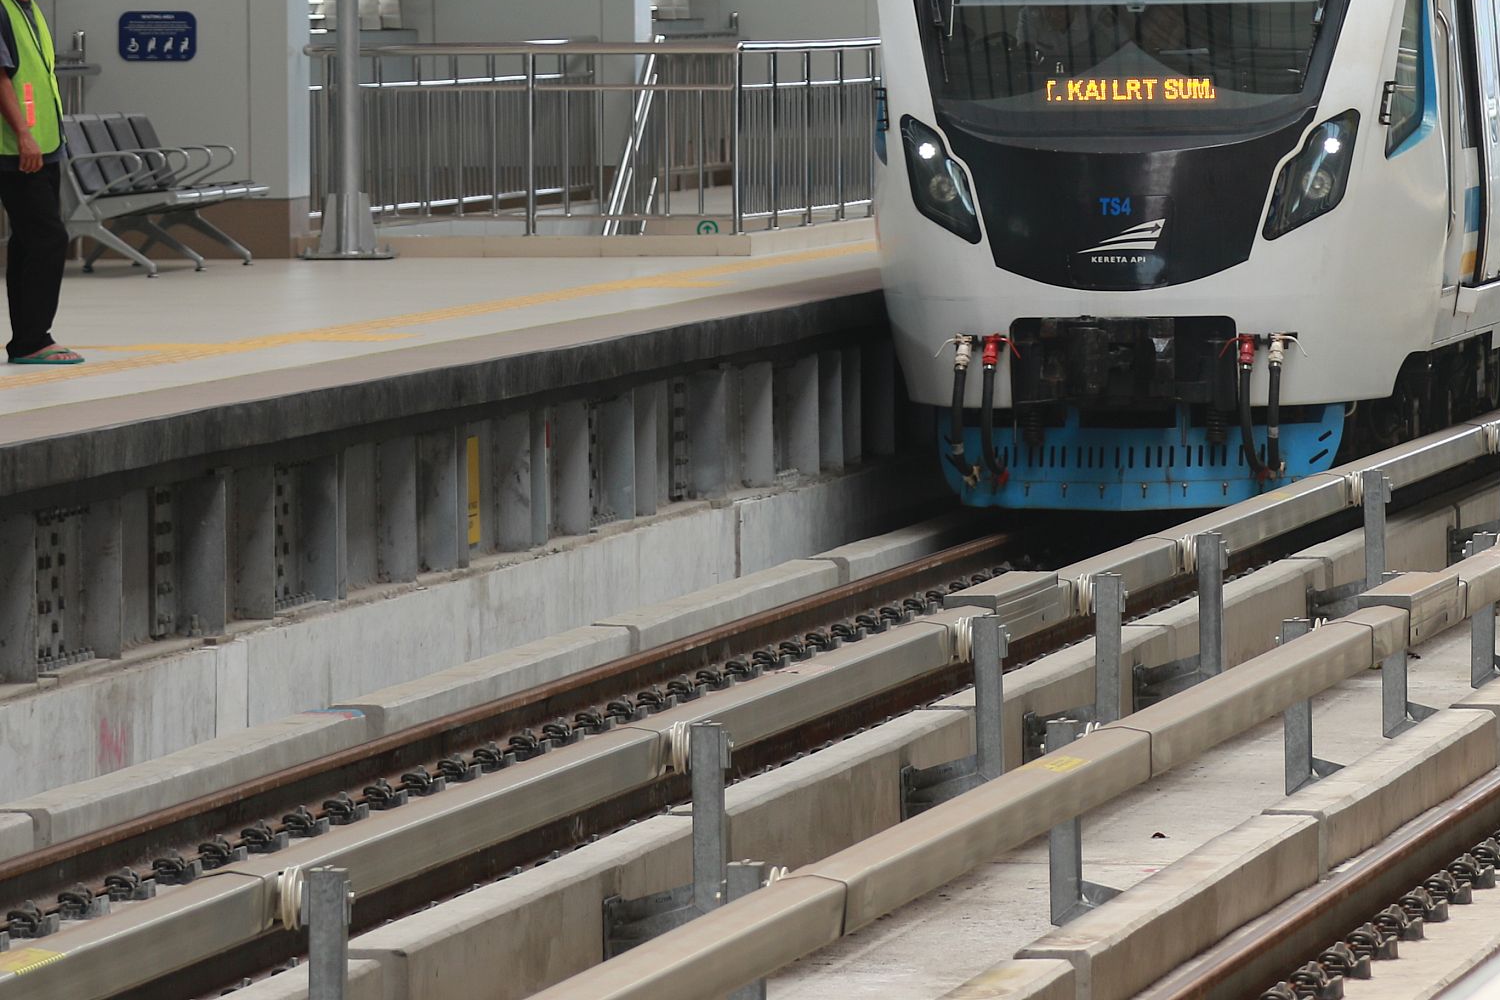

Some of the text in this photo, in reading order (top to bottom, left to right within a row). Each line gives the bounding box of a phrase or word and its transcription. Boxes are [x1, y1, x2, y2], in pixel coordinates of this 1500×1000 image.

[1067, 79, 1107, 101] KAI
[1112, 78, 1158, 101] LRT
[1099, 197, 1132, 216] TS4
